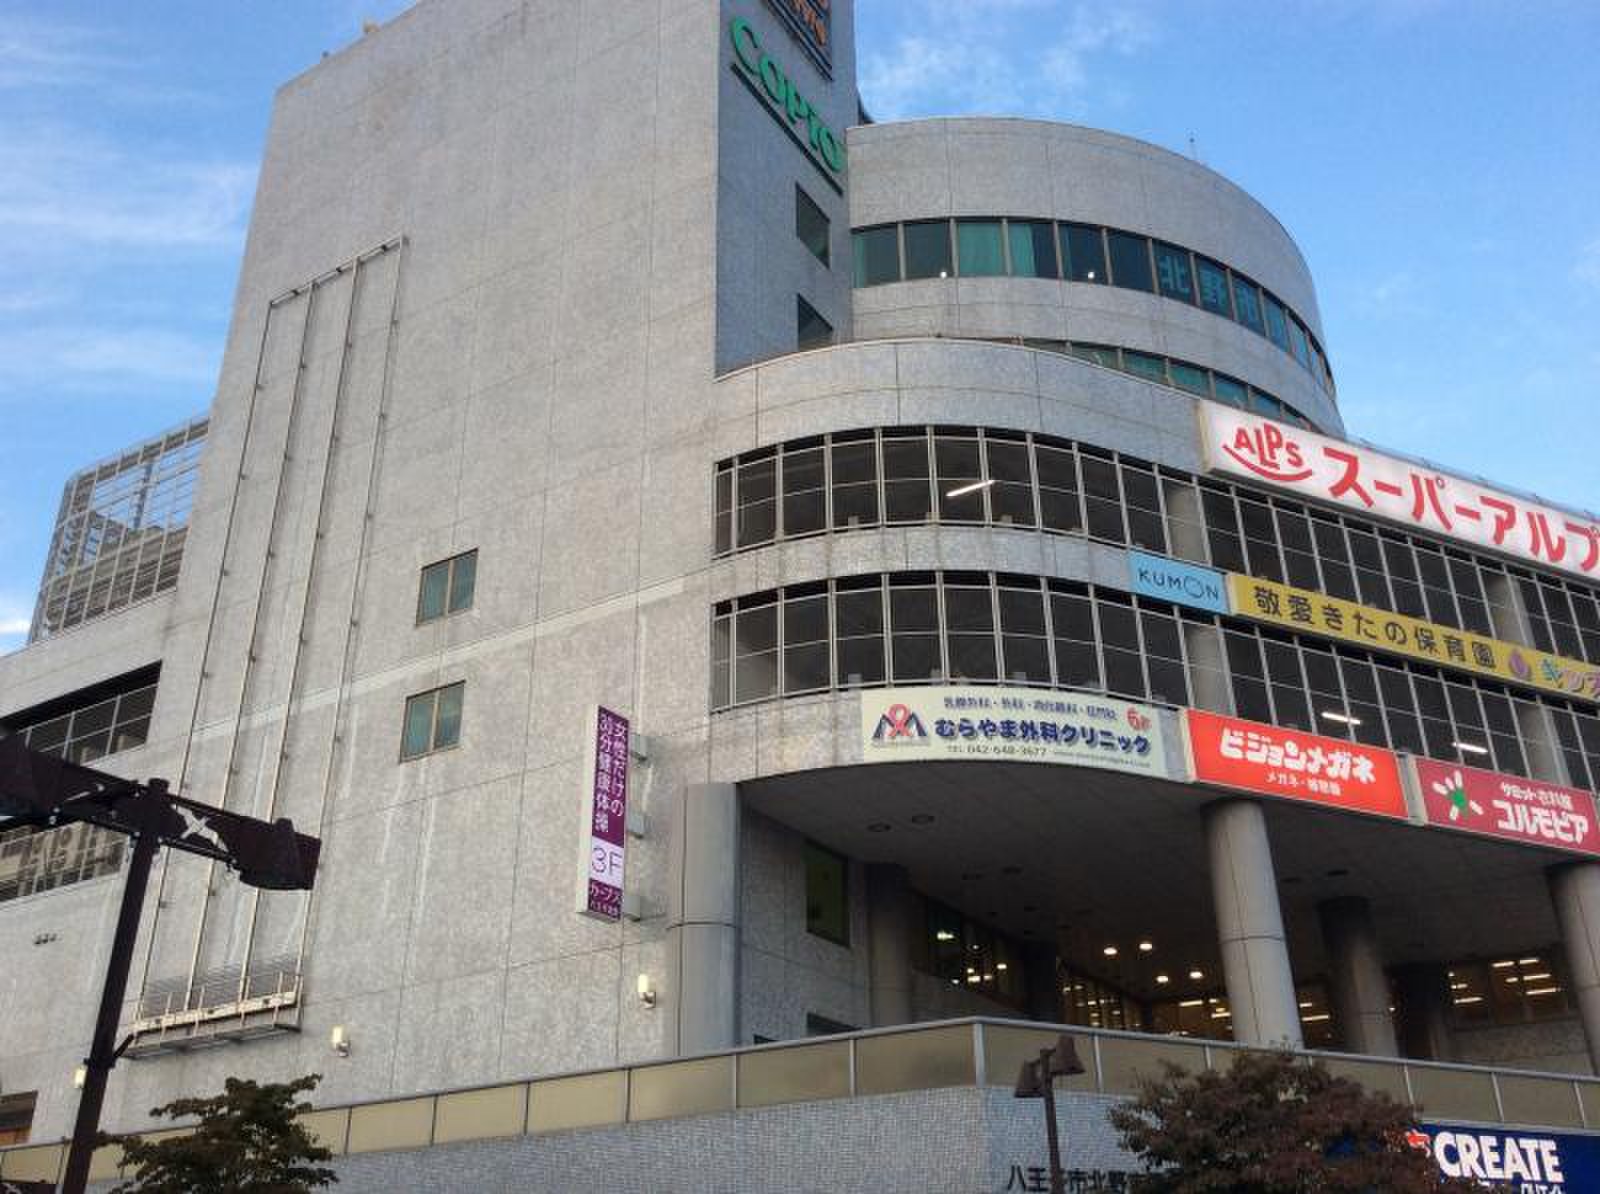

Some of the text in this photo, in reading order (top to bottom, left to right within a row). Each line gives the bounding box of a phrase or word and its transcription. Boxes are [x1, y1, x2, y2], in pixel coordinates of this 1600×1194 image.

[1232, 422, 1304, 470] ALPS
[1137, 568, 1219, 601] KUMON
[1253, 585, 1496, 669] 敬愛きたの保育園
[934, 717, 1151, 754] むらやま外科クリニック
[1219, 727, 1377, 784] ビジョンメガネ
[1492, 798, 1589, 845] コルモピア
[592, 847, 623, 877] 3F
[1434, 1131, 1564, 1183] CREATE
